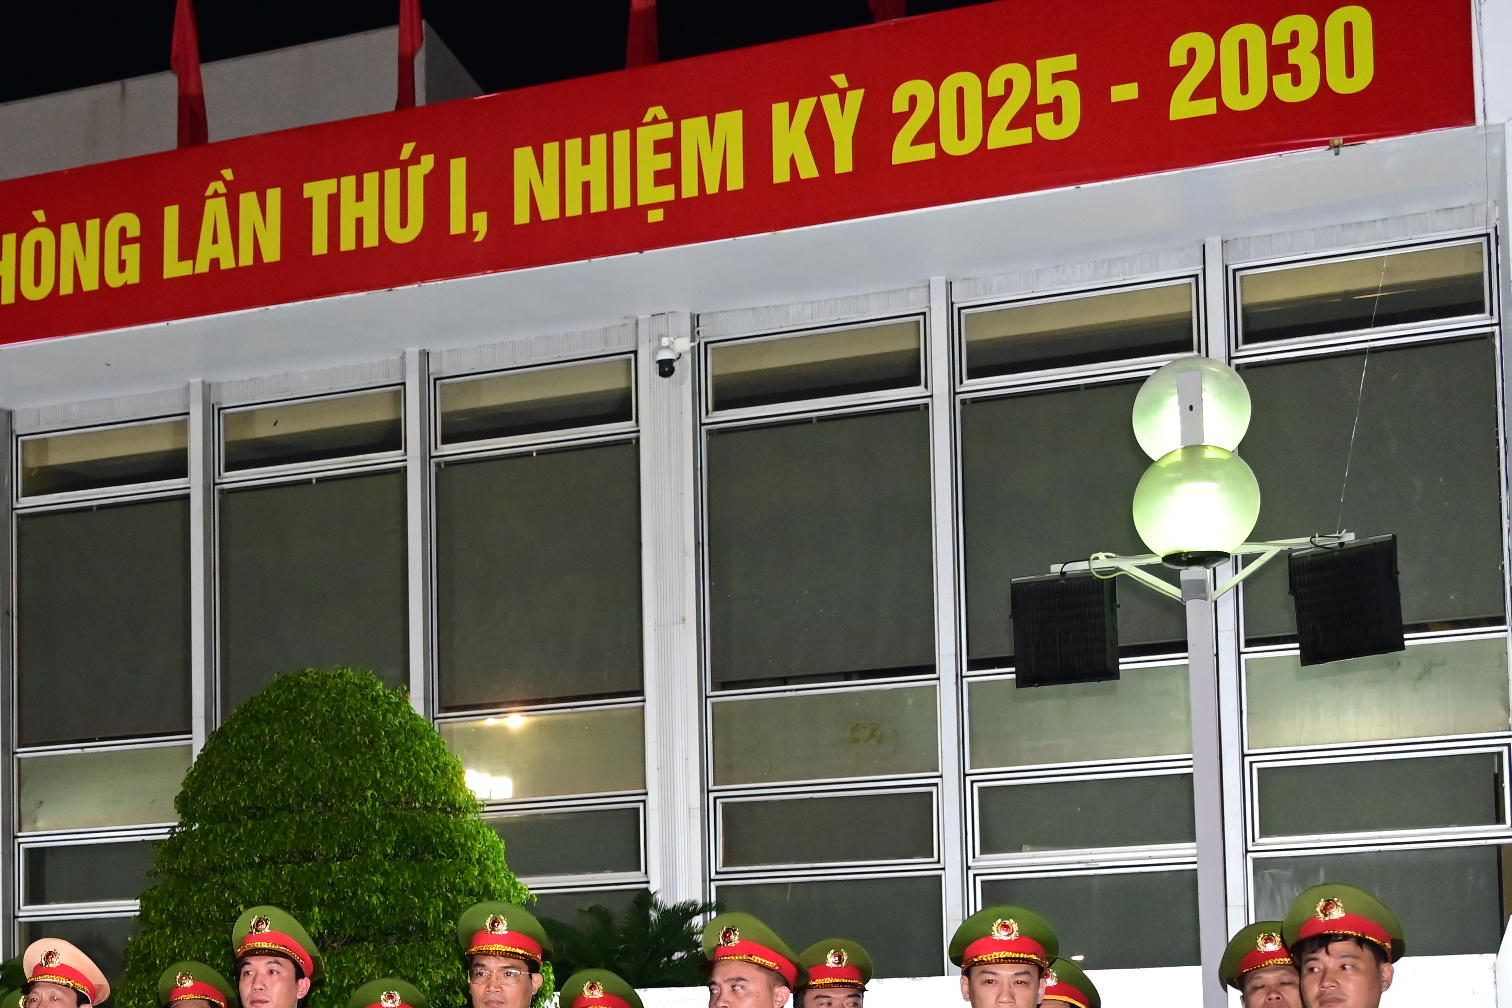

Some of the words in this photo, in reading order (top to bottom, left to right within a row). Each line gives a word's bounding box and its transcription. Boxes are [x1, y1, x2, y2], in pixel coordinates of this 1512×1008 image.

[163, 169, 282, 279] LẦN
[303, 142, 435, 256] THỨ
[450, 157, 488, 242] I,
[514, 106, 745, 225] NHIỆM
[772, 74, 865, 184] KỲ
[892, 53, 1081, 165] 2025
[1169, 5, 1375, 121] 2030
